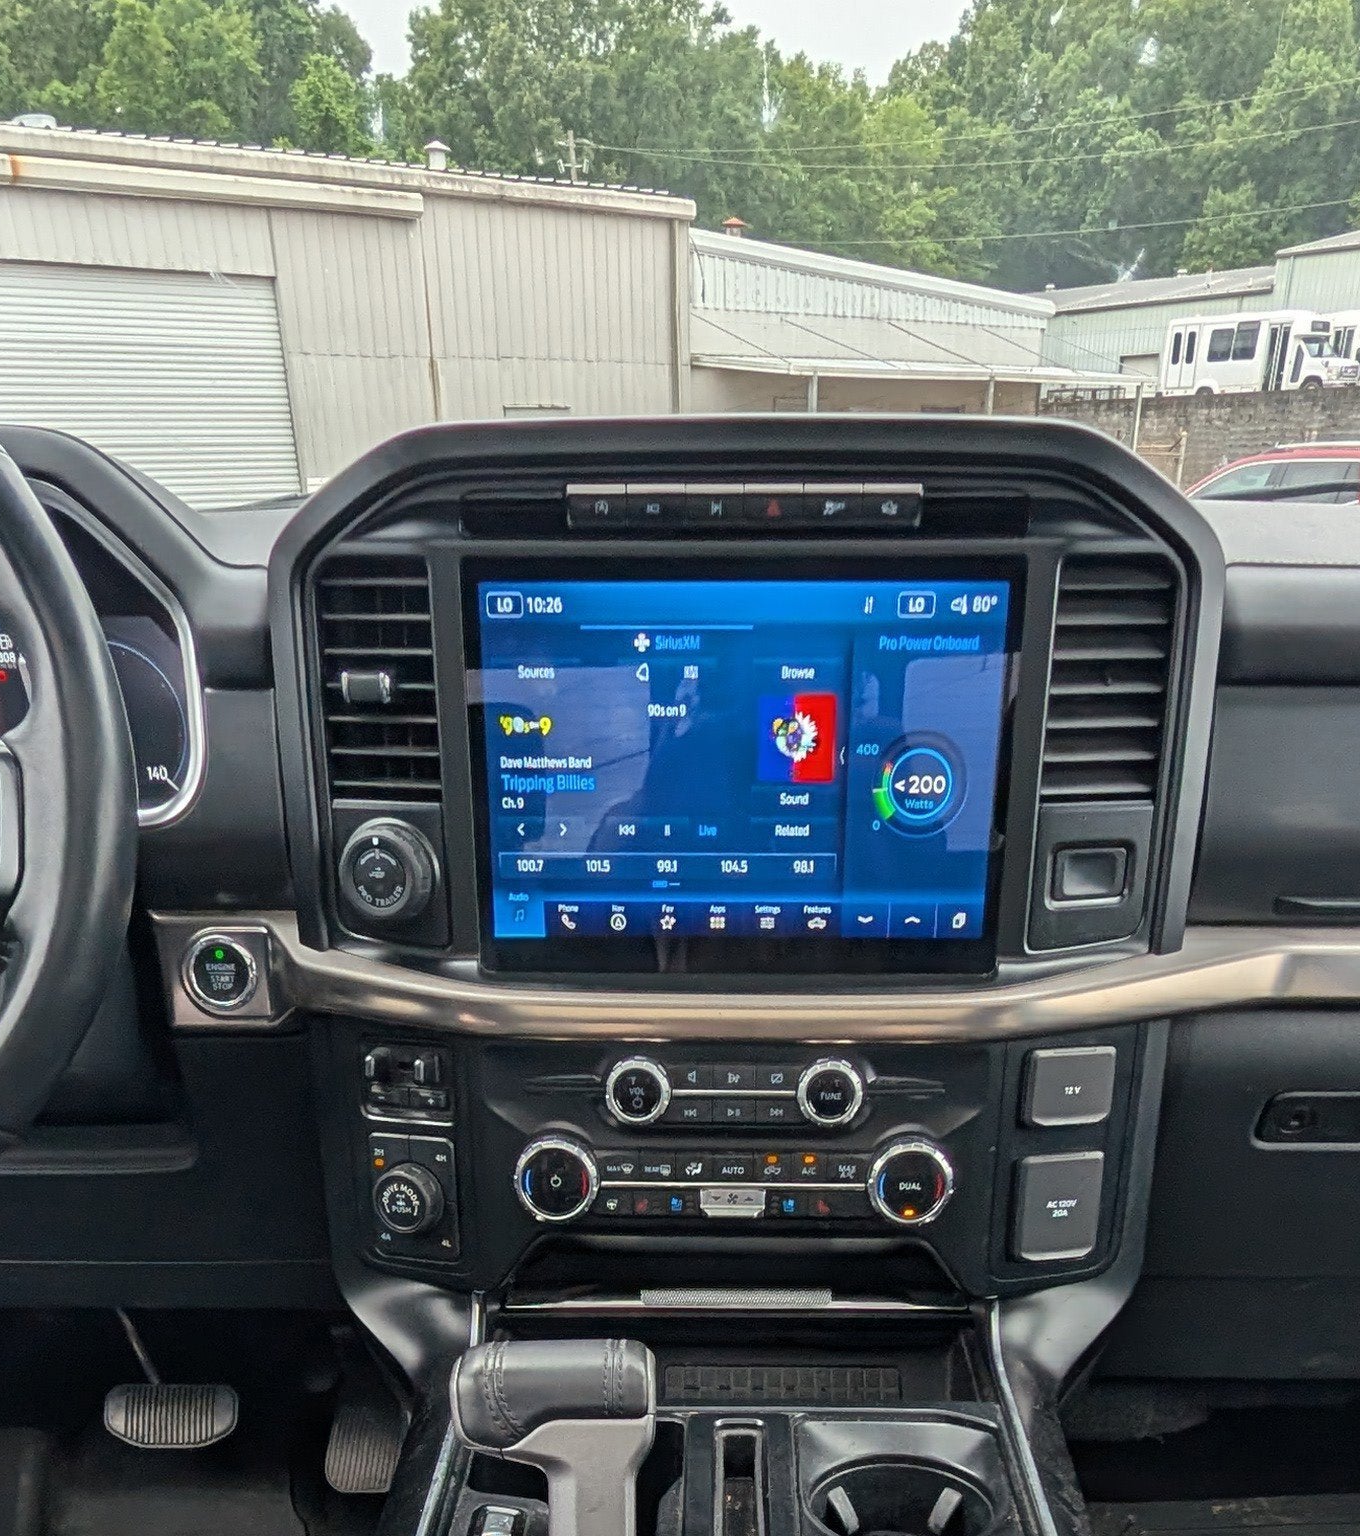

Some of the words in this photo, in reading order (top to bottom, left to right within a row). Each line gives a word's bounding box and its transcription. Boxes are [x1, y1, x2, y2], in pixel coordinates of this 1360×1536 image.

[497, 597, 514, 613] LO
[527, 596, 563, 614] 10:26
[908, 597, 925, 613] LO
[655, 634, 700, 650] SiriusXM
[879, 635, 898, 650] Pro
[900, 635, 933, 650] Power
[933, 635, 980, 650] Onboard
[517, 665, 556, 679] Sources
[781, 665, 815, 679] Browse
[647, 703, 666, 717] 90s
[666, 706, 679, 717] on
[856, 743, 879, 755] 400
[500, 756, 523, 769] Dave
[524, 756, 568, 769] Matthews
[568, 756, 592, 769] Band
[146, 764, 168, 780] 140
[501, 774, 555, 794] Tripping
[556, 774, 595, 790] Billies
[779, 792, 810, 805] Sound
[905, 799, 934, 810] Watts
[699, 824, 717, 836] Live
[775, 824, 810, 837] Related
[517, 859, 544, 872] 100.7
[586, 859, 610, 872] 101.5
[657, 859, 678, 872] 99.1
[720, 859, 748, 873] 104.5
[793, 860, 815, 873] 98.1
[358, 885, 373, 903] PRO
[375, 885, 404, 907] TRAILER
[205, 963, 237, 971] ENGINE
[211, 975, 235, 983] START
[212, 983, 234, 991] STOP
[721, 1166, 745, 1174] AUTO
[899, 1182, 921, 1190] DUAL
[382, 1183, 399, 1204] DRIVE
[400, 1183, 420, 1206] MODE
[391, 1205, 412, 1213] PUSH
[1046, 1200, 1058, 1208] AC
